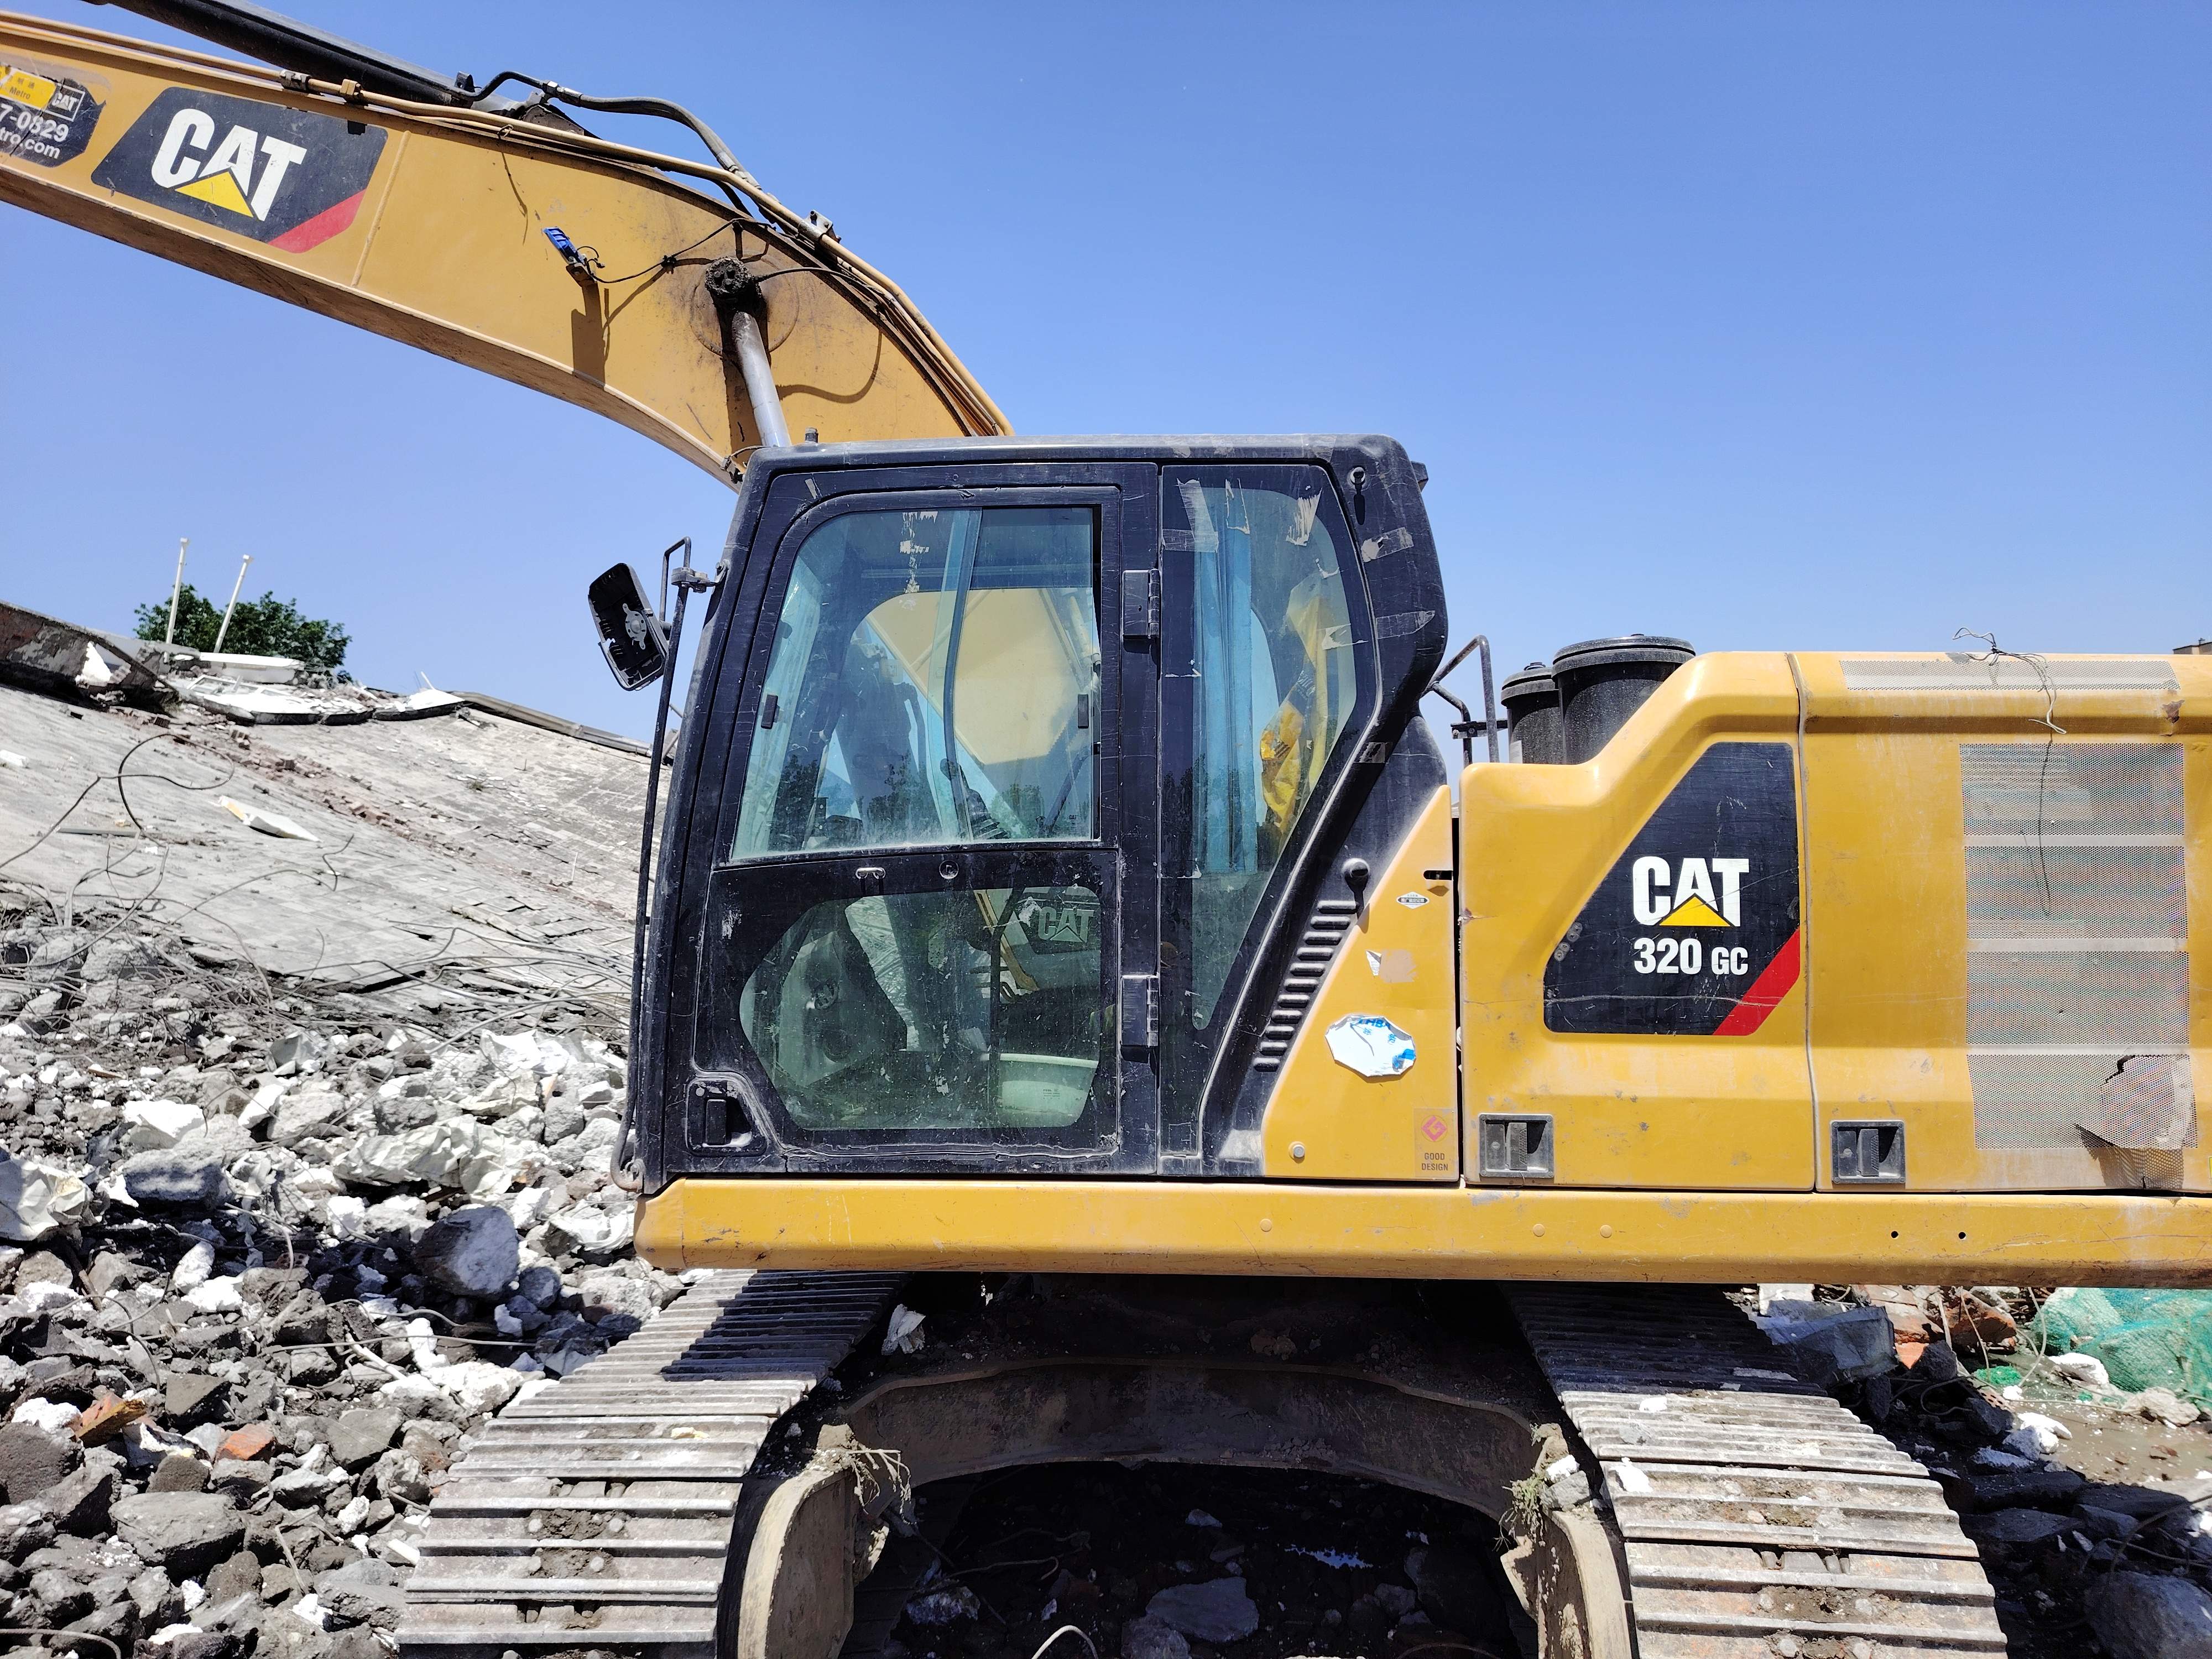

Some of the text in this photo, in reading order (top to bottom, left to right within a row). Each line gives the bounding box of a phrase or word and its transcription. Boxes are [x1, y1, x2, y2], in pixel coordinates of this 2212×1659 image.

[9, 86, 30, 100] Metro
[52, 92, 79, 111] CAT
[0, 103, 69, 143] 7-0829
[150, 108, 307, 222] CAT
[1632, 855, 1749, 927] CAT
[1038, 906, 1094, 943] CAT
[1634, 937, 1749, 975] 320 GC
[1424, 1152, 1445, 1160] GOOD
